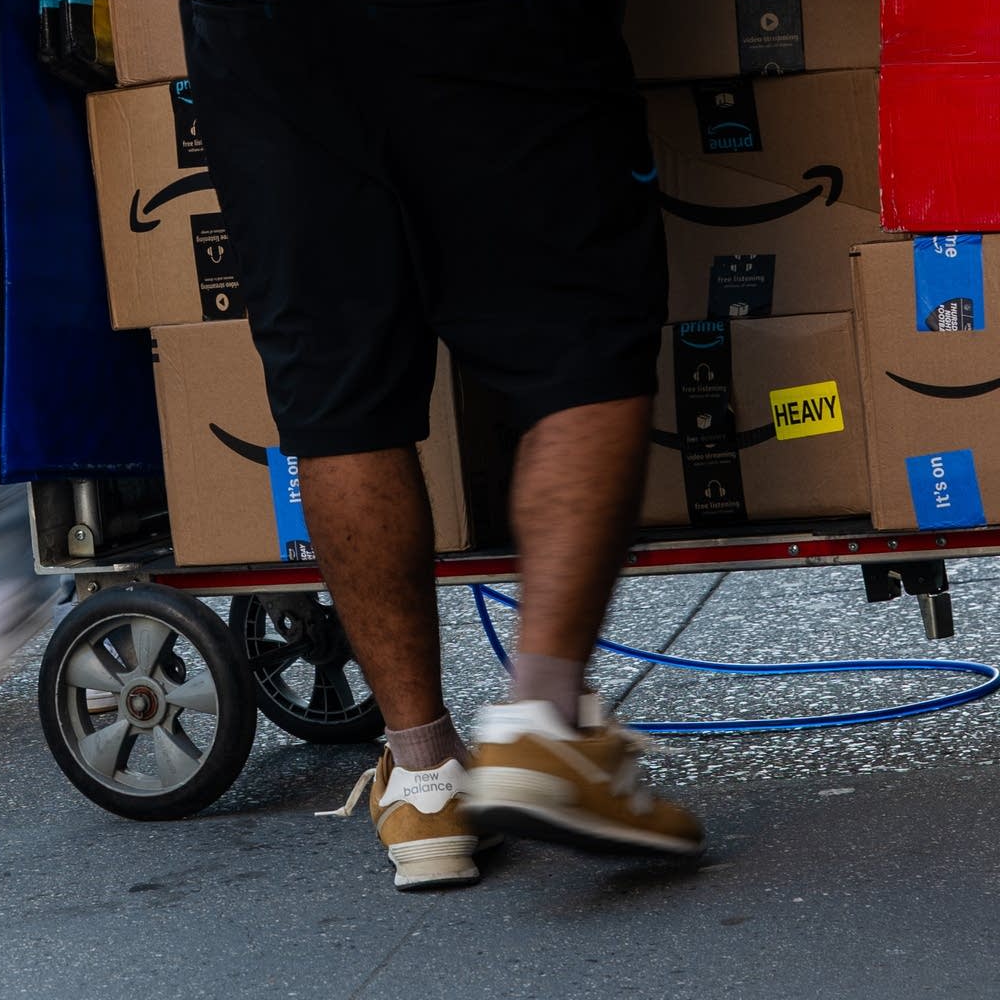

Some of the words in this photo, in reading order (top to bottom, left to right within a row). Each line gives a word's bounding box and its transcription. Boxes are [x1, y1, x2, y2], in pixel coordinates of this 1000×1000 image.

[710, 132, 753, 151] prime
[680, 320, 725, 336] prime
[774, 396, 837, 428] HEAVY
[286, 456, 299, 476] on
[930, 456, 945, 478] on
[288, 479, 301, 503] It's
[933, 481, 951, 508] It's
[414, 773, 439, 783] new
[403, 782, 453, 797] balance
